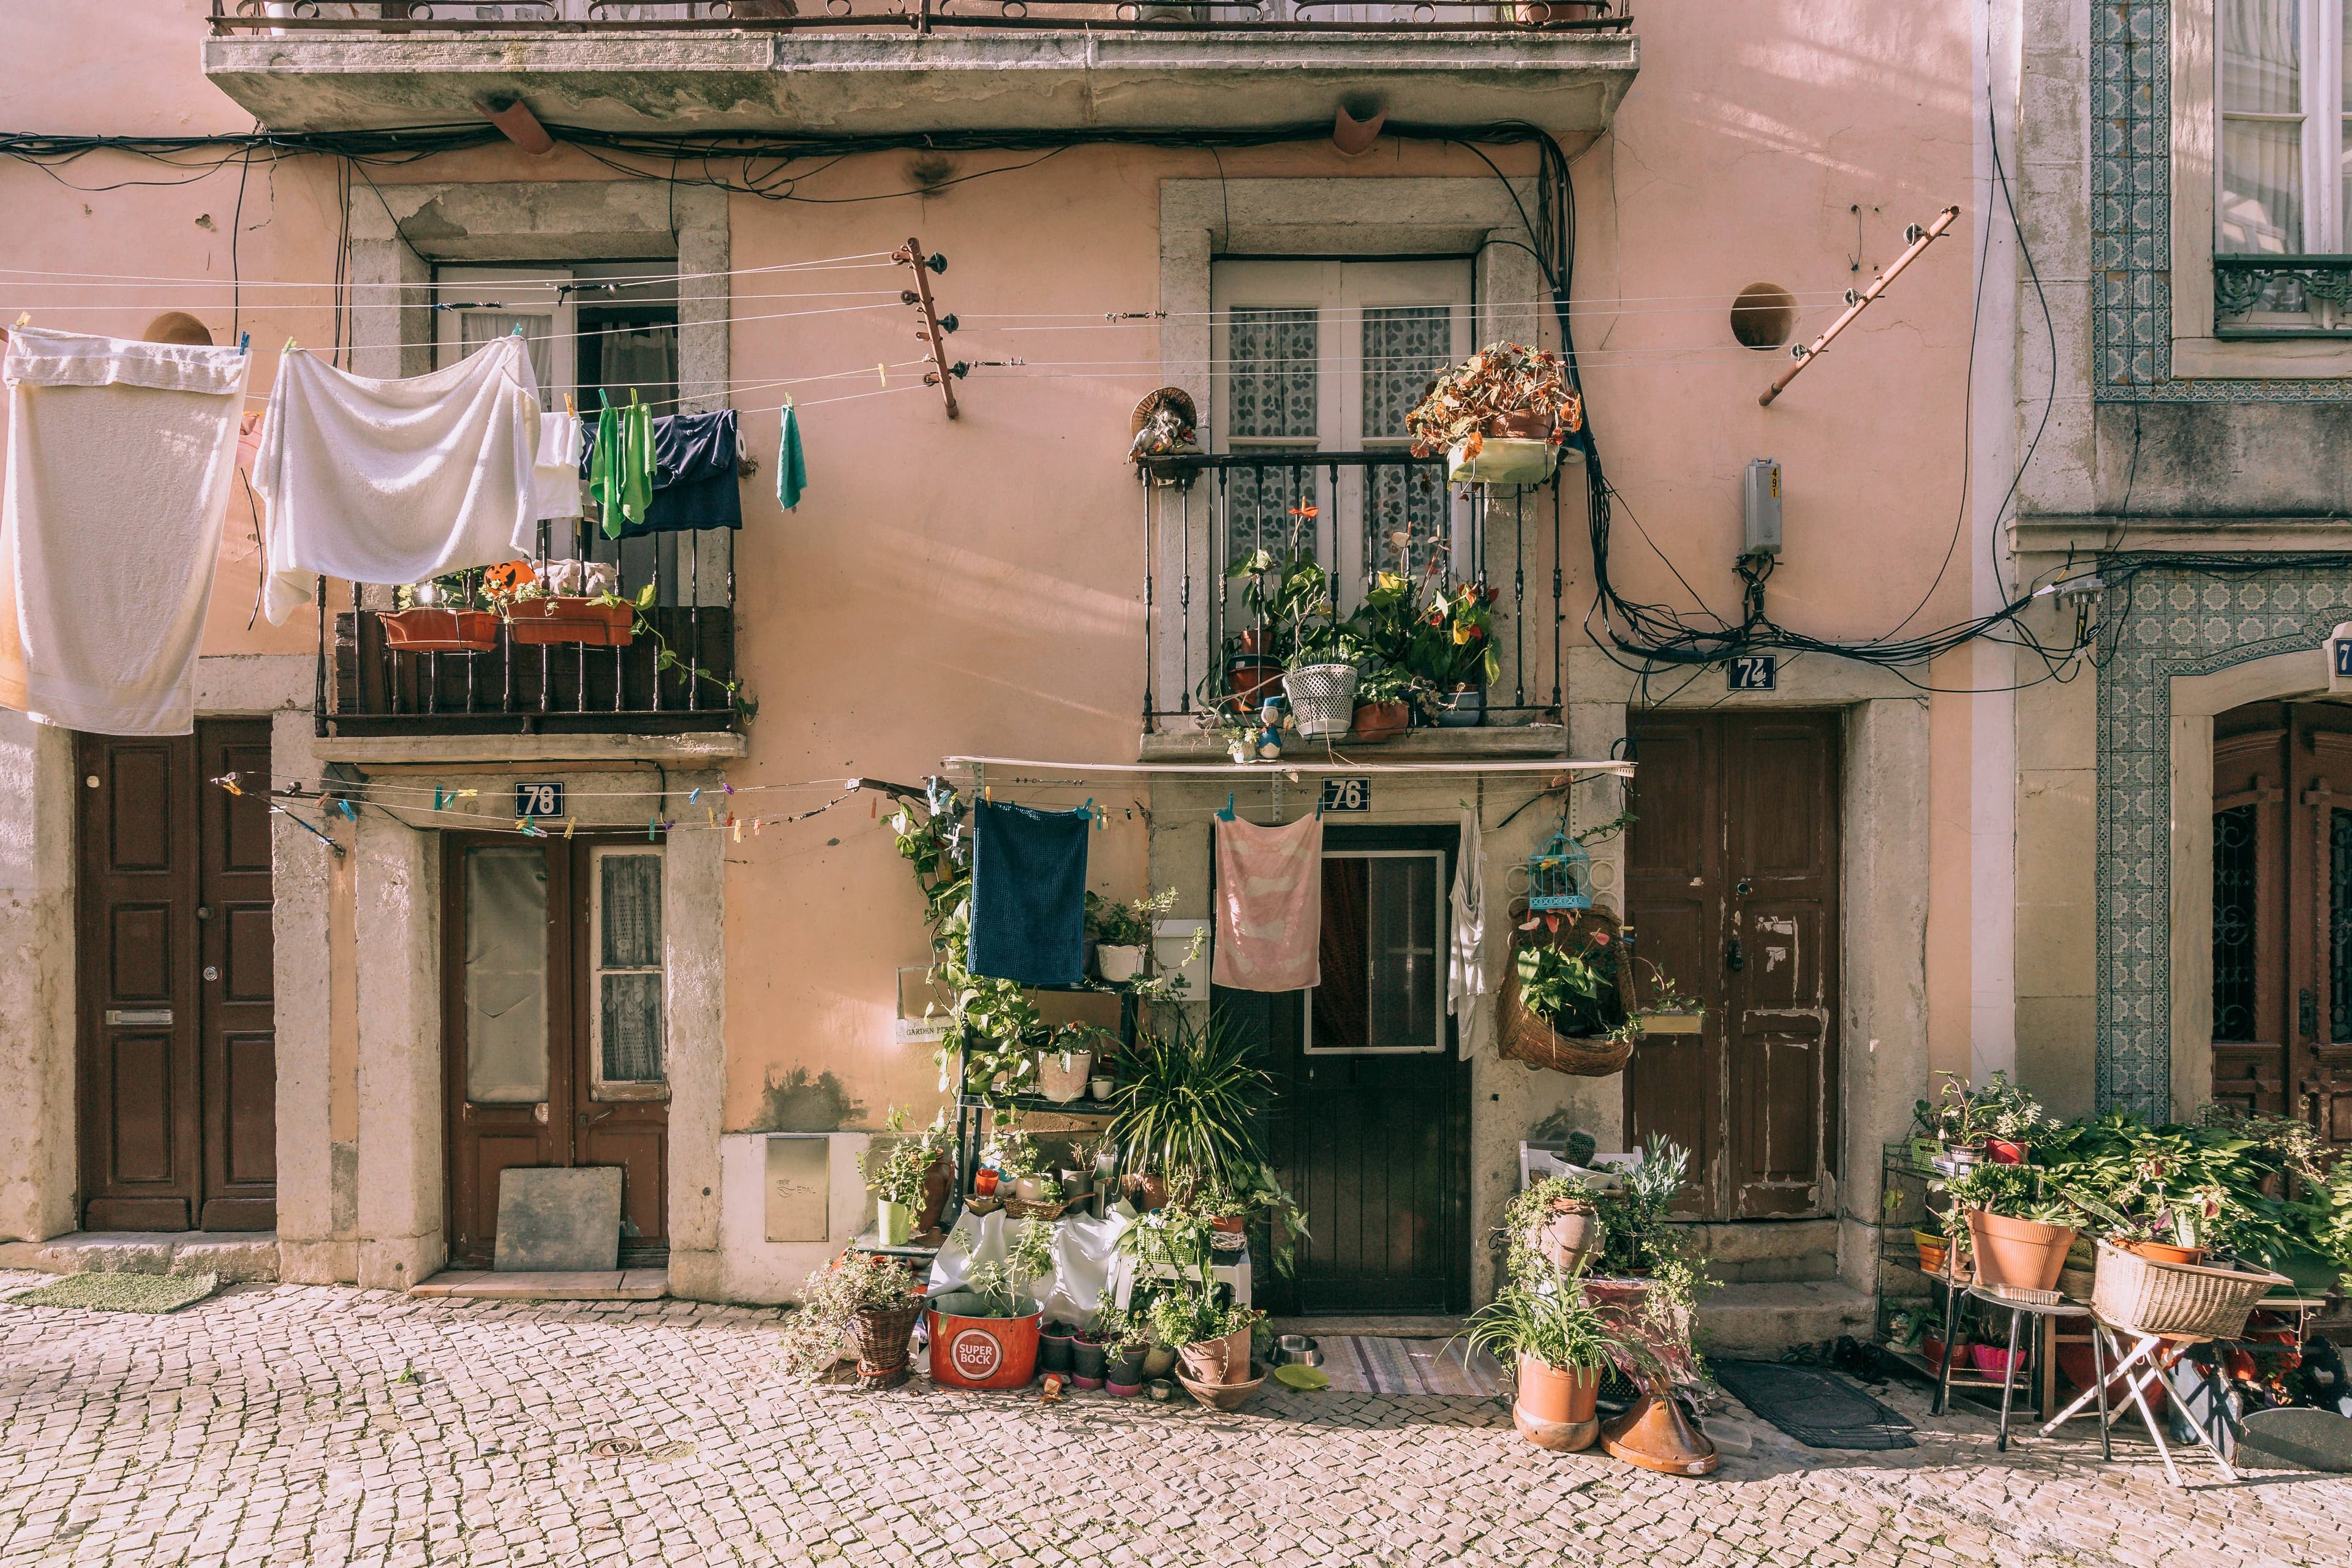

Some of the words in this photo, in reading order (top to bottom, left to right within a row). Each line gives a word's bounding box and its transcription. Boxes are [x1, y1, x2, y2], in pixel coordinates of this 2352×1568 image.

[1738, 658, 1766, 687] 74
[524, 786, 554, 814] 78
[1332, 780, 1361, 809] 76
[907, 1027, 934, 1036] GARDEN
[797, 1186, 816, 1194] EPAL
[959, 1344, 992, 1355] SUPER
[960, 1353, 990, 1365] BOCK
